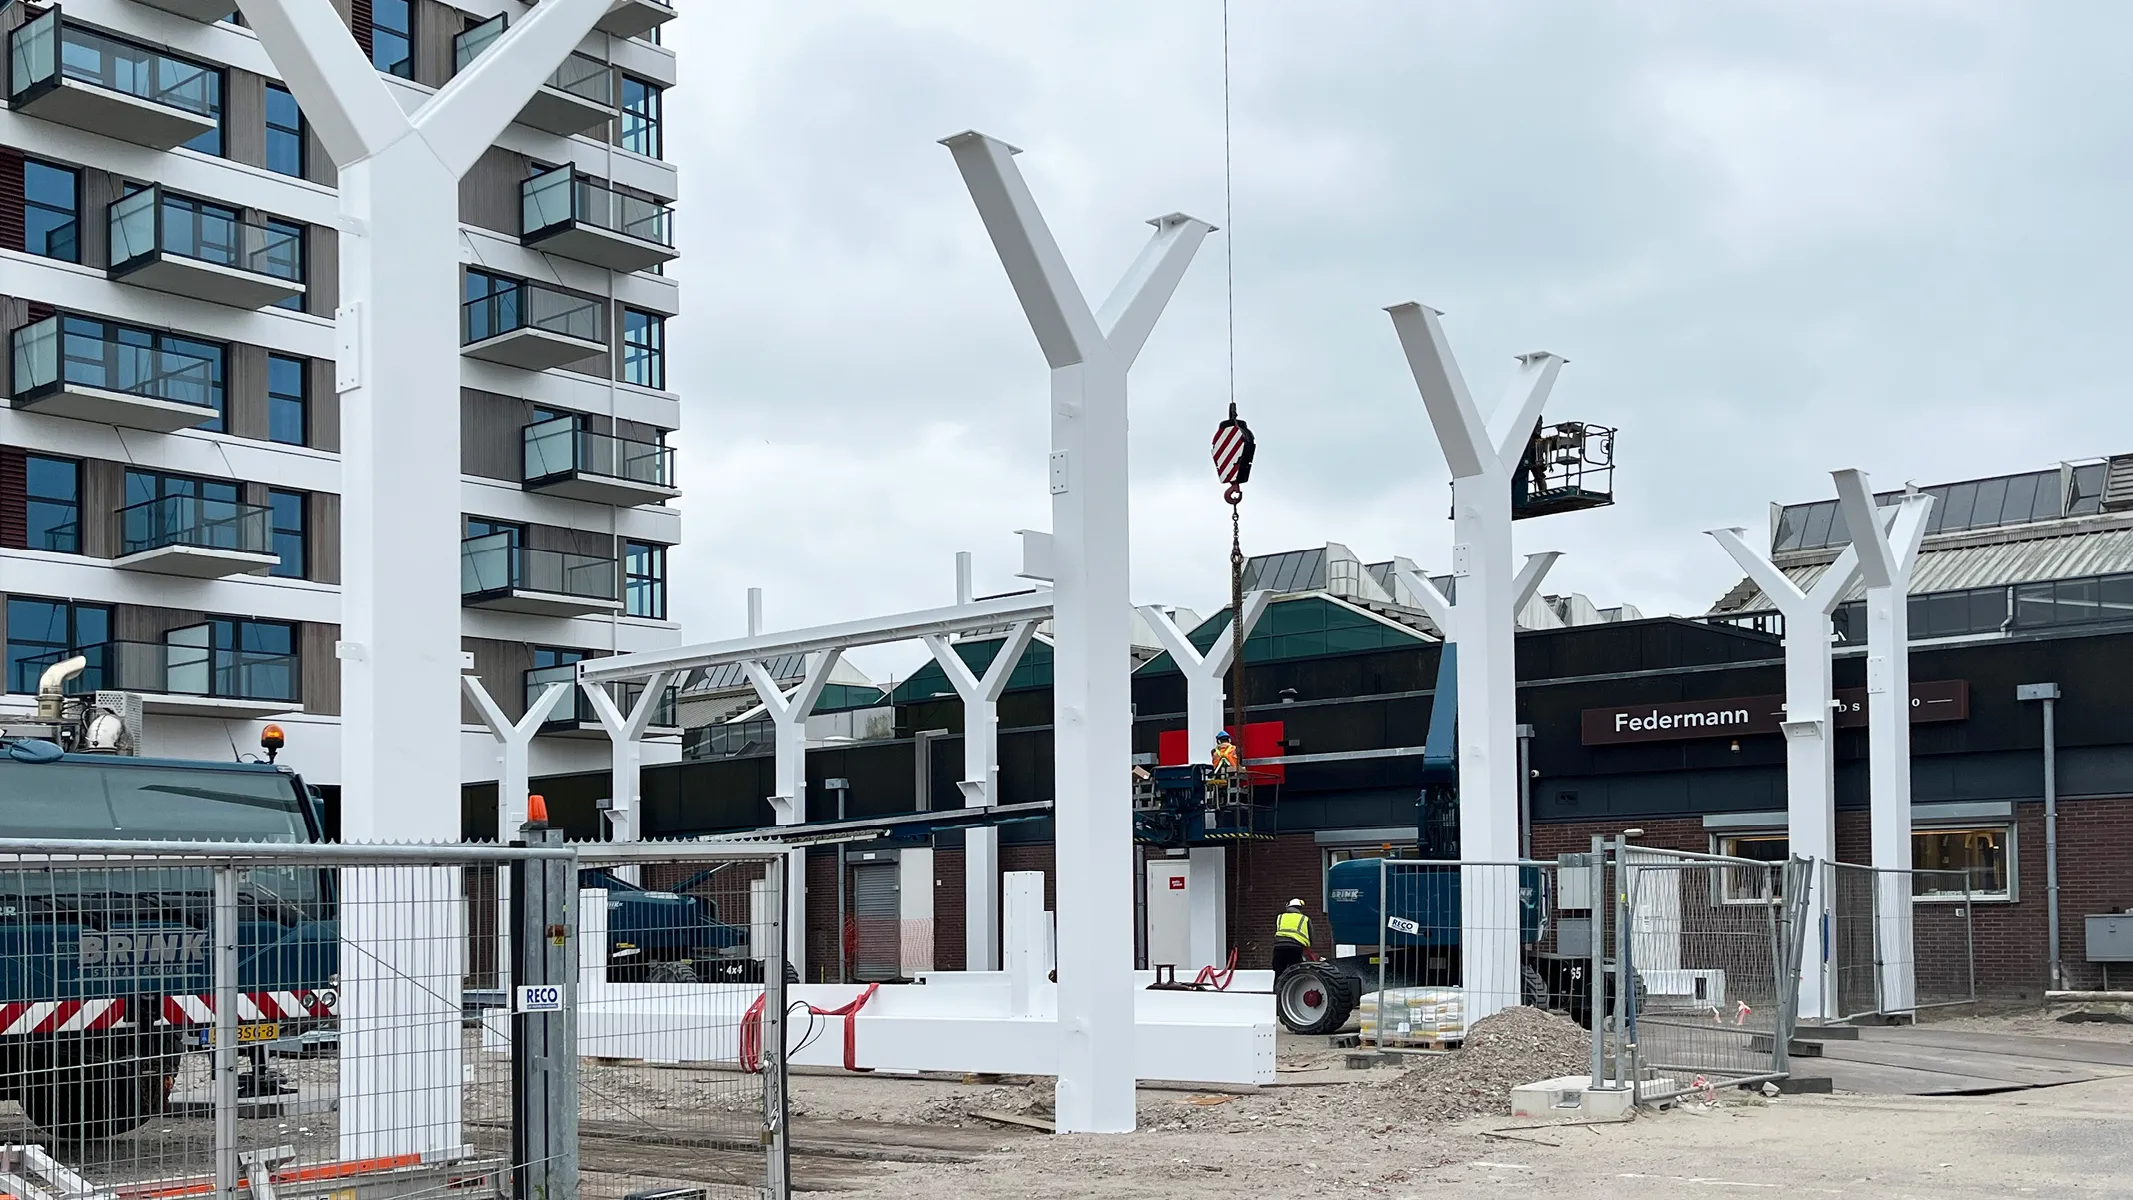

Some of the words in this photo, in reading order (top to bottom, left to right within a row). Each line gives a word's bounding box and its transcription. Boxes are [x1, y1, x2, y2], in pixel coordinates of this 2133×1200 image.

[1615, 709, 1749, 732] Federmann
[1392, 918, 1413, 930] RECO
[78, 934, 208, 965] BRINK
[92, 965, 185, 978] STAABOUW
[726, 965, 743, 975] 4x4
[526, 988, 558, 1003] RECO
